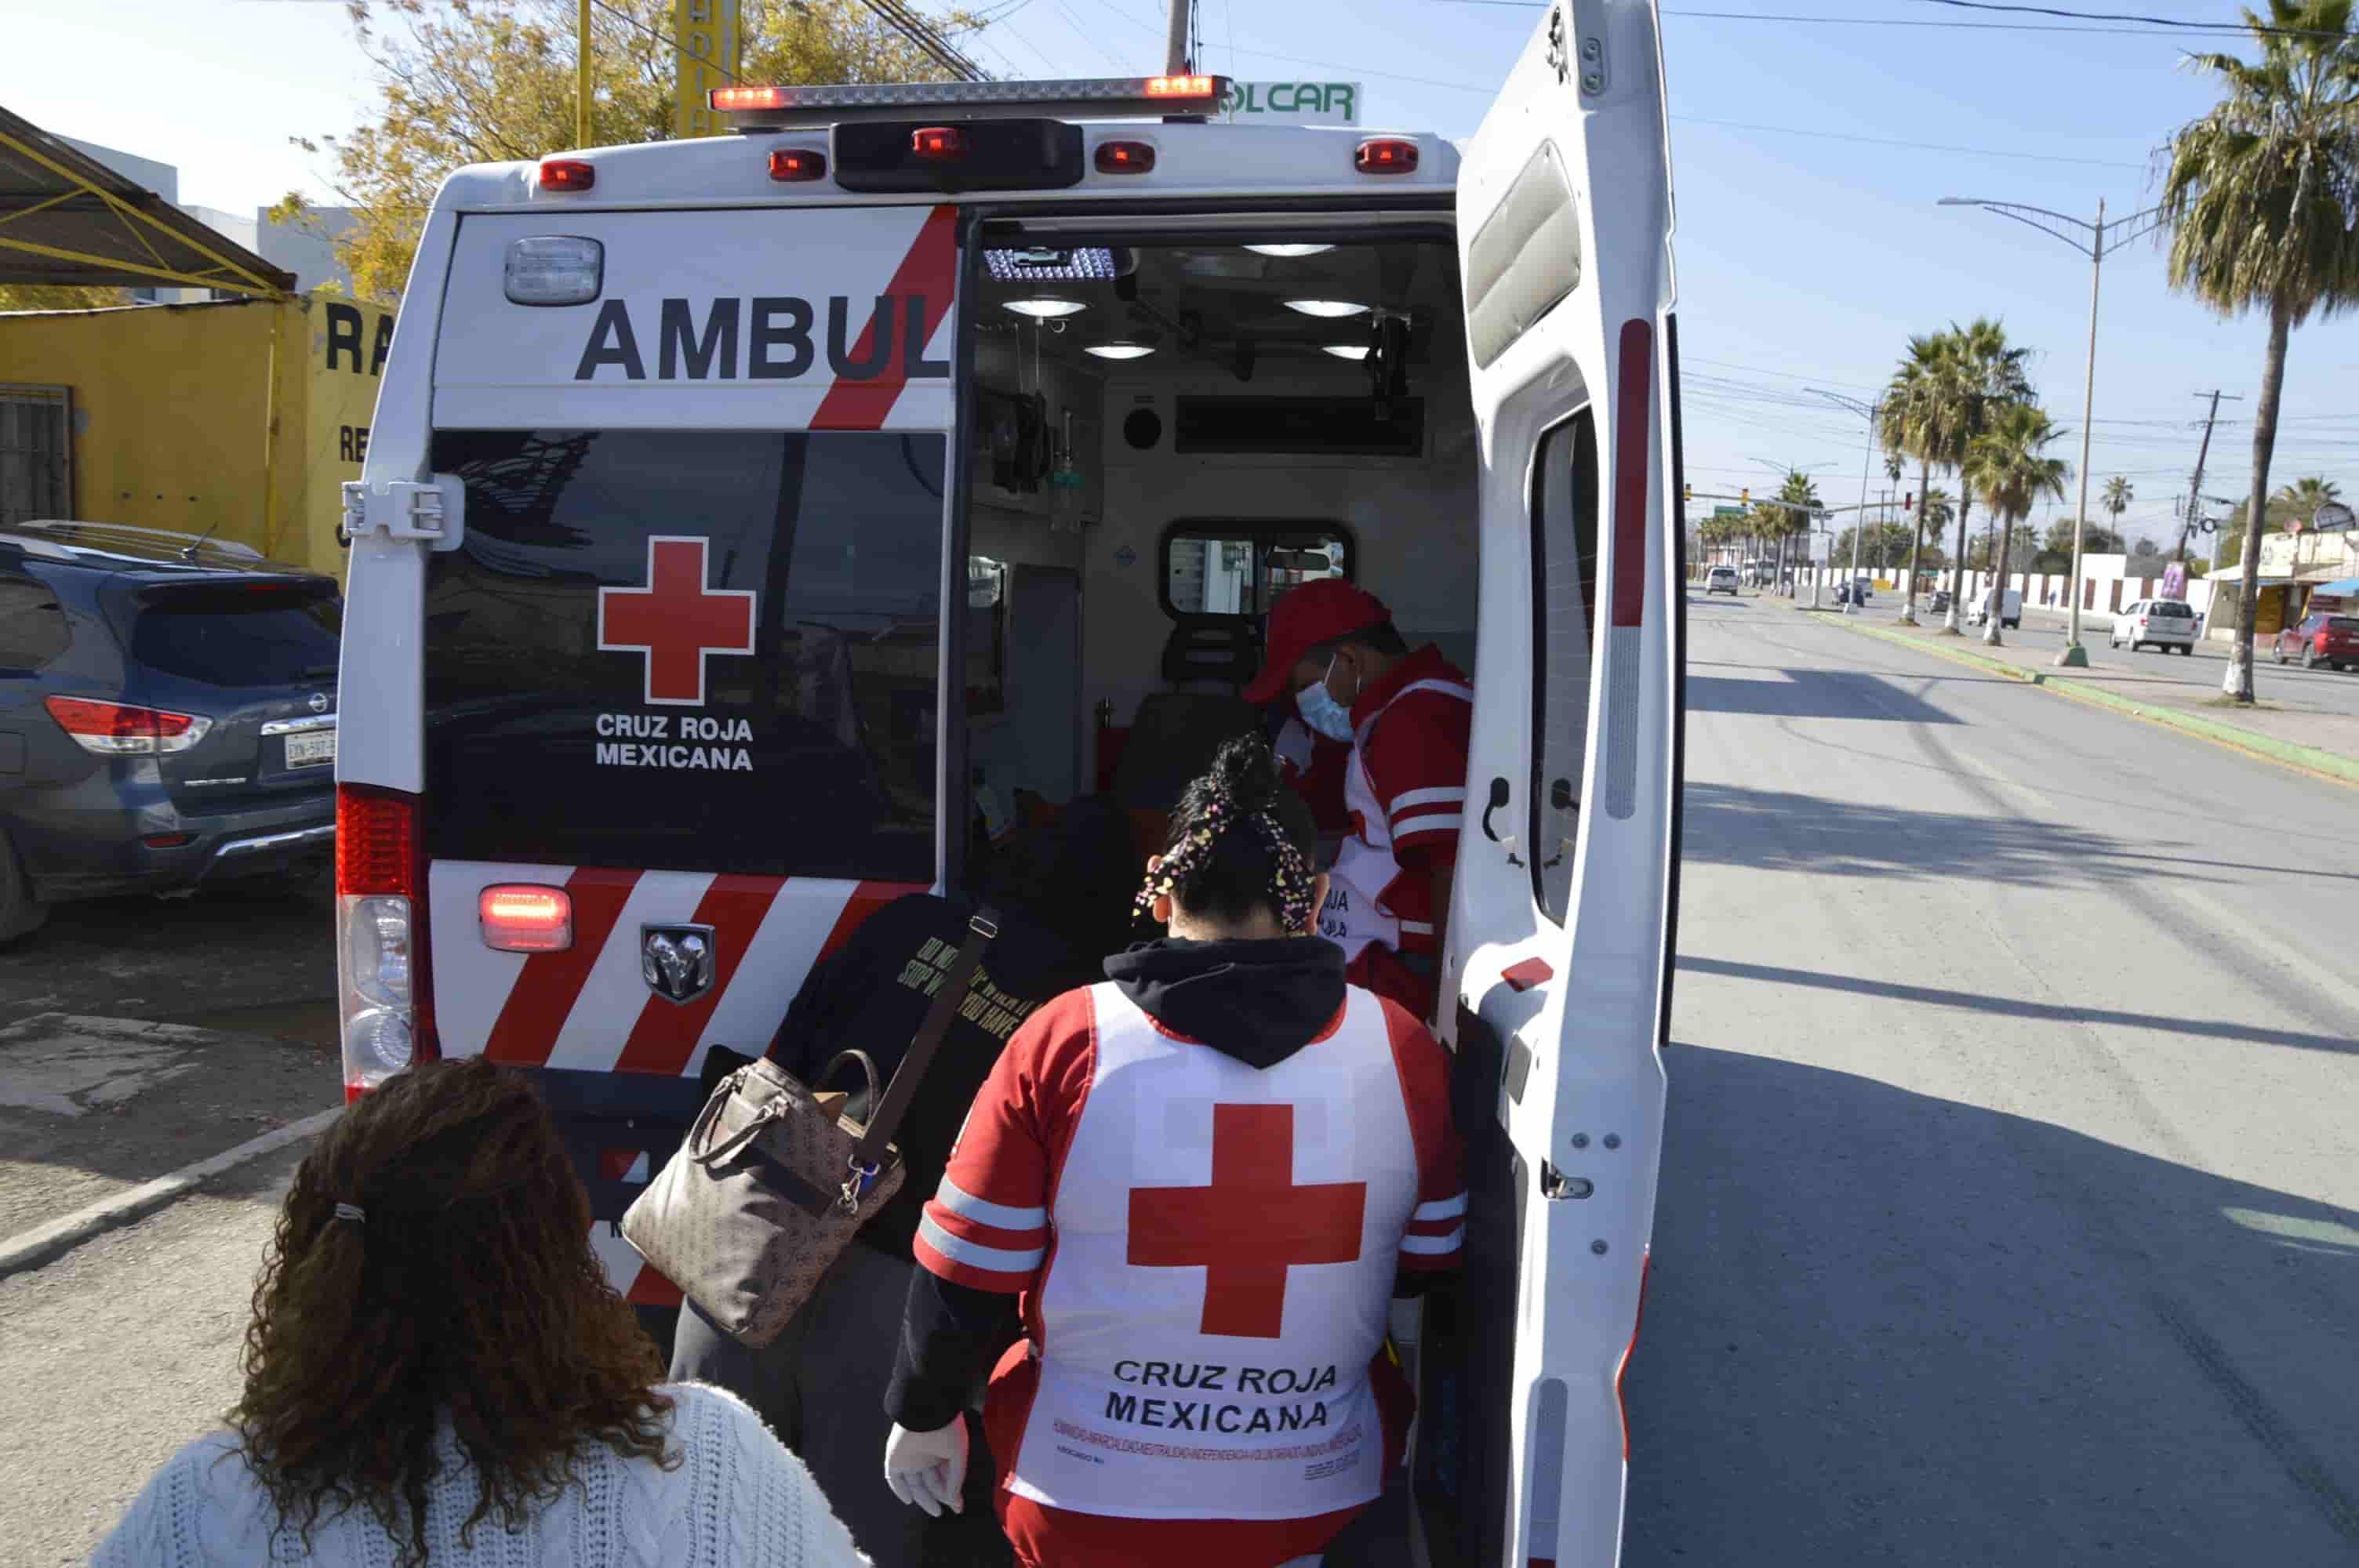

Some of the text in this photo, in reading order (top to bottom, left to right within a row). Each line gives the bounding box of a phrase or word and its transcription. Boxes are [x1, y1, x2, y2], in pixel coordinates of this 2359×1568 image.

[575, 296, 951, 381] AMBUL
[596, 713, 753, 742] CRUZ ROJA
[596, 742, 753, 771] MEXICANA
[1113, 1359, 1338, 1395] CRUZ ROJA
[1105, 1391, 1329, 1433] MEXICANA
